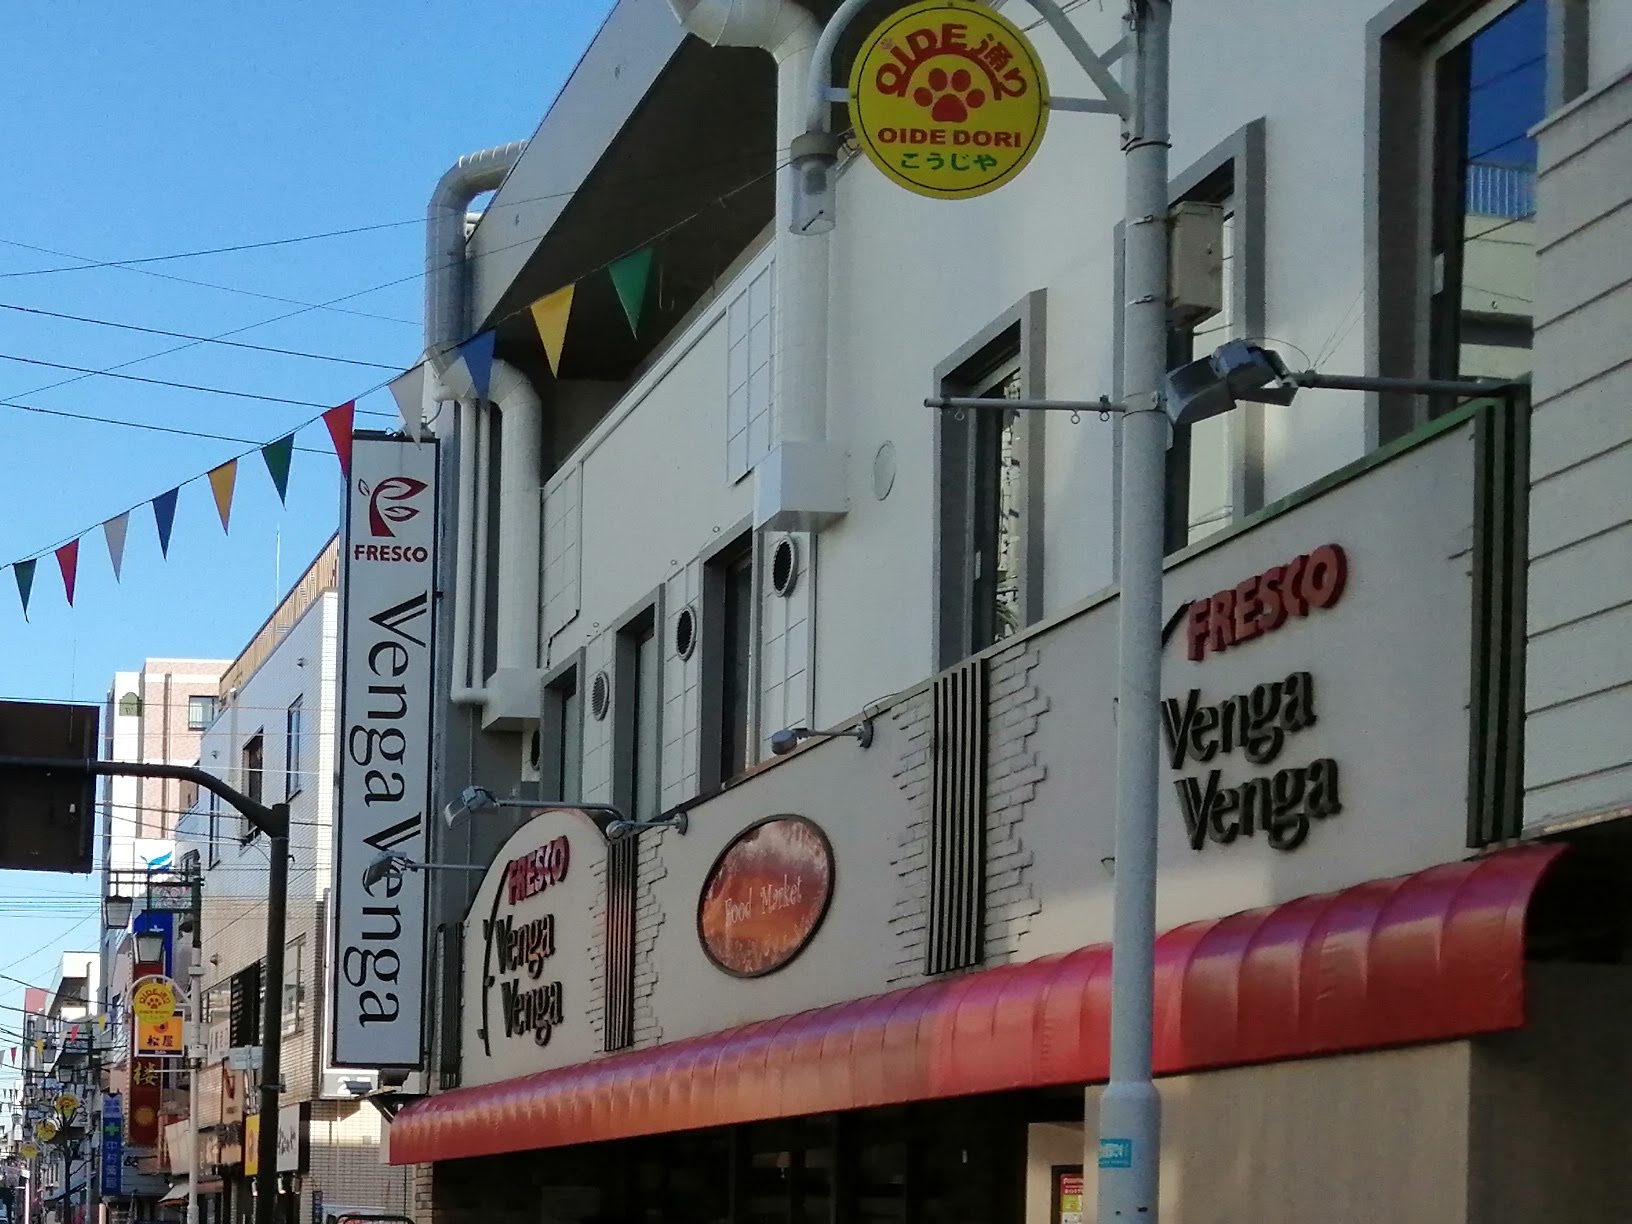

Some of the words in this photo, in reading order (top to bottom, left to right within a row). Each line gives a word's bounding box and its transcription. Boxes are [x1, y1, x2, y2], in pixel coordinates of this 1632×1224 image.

[878, 128, 946, 145] OIDE
[953, 130, 1021, 148] DORI
[901, 153, 998, 171] こうじや
[354, 545, 428, 563] FRESCO
[1187, 543, 1347, 661] FRESCO
[349, 590, 428, 808] Venga
[1162, 672, 1317, 769] Venga
[1174, 758, 1342, 851] Venga
[508, 835, 570, 905] FRESCO
[725, 886, 753, 925] Food
[760, 873, 803, 915] Market
[495, 914, 556, 980] Venga
[146, 1035, 173, 1047] 松屋
[501, 978, 564, 1047] Venga
